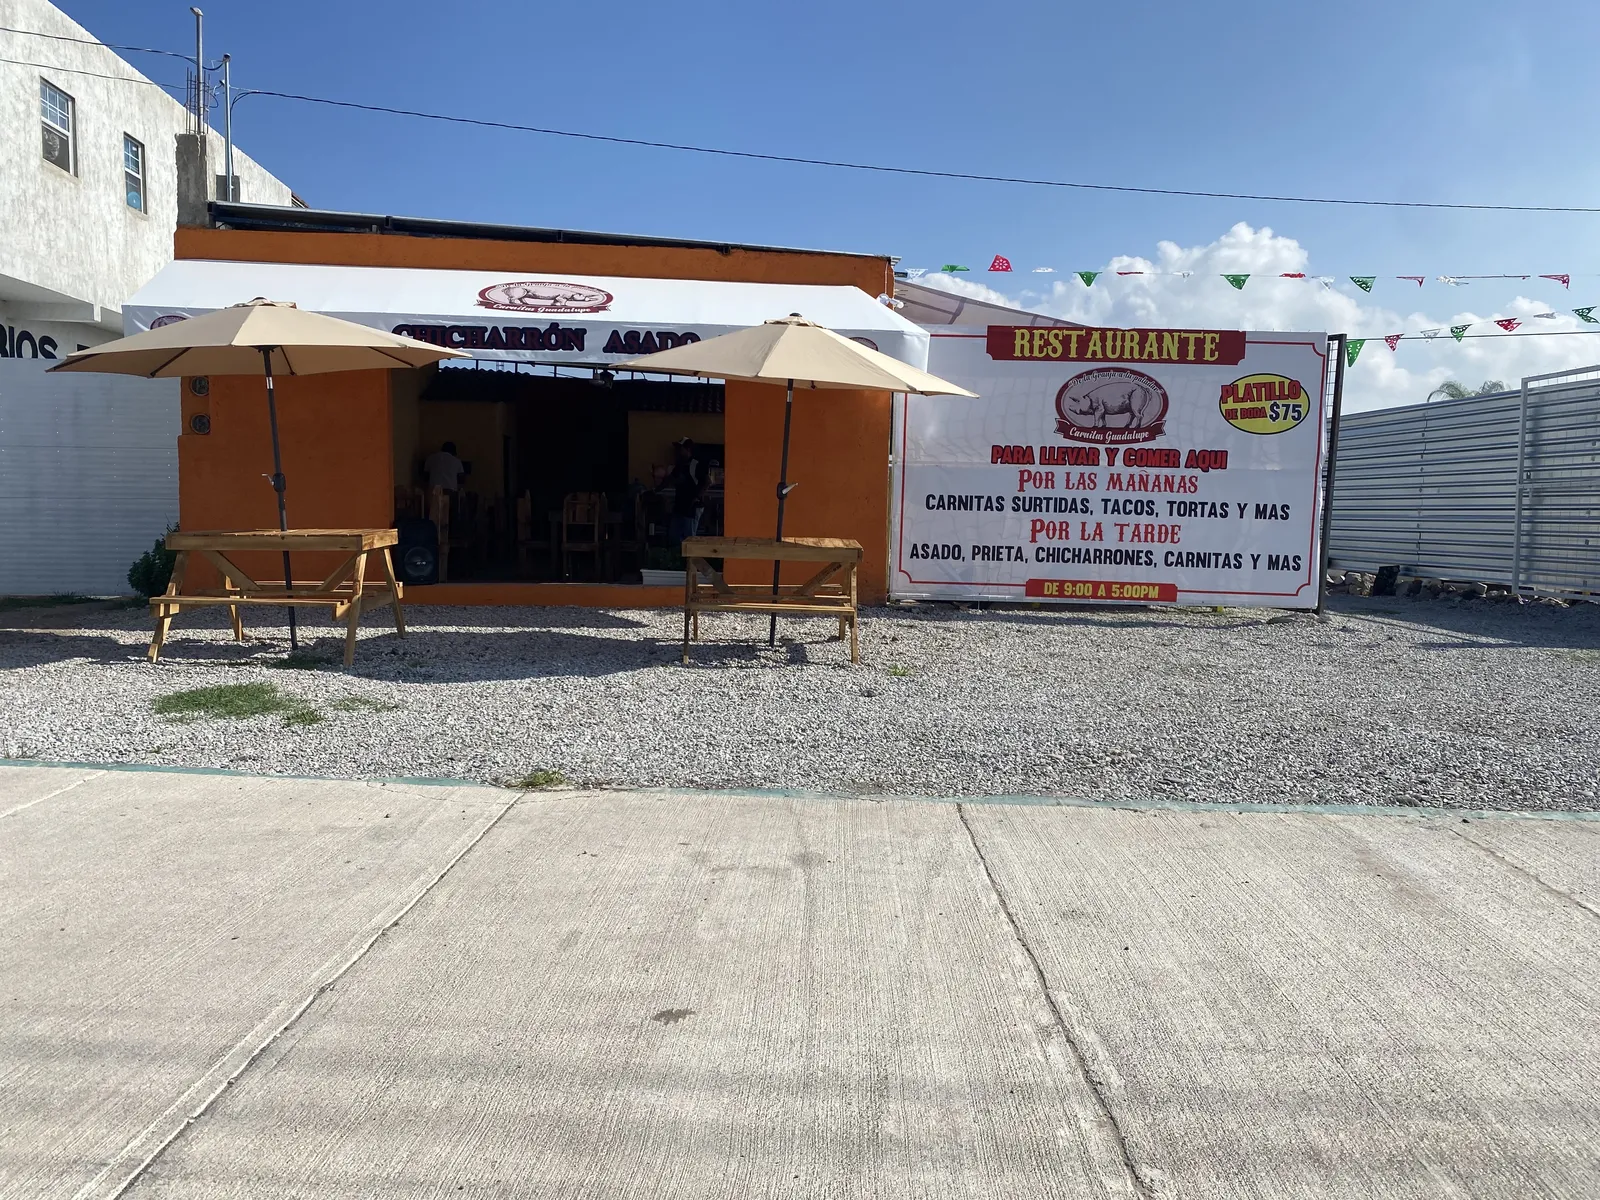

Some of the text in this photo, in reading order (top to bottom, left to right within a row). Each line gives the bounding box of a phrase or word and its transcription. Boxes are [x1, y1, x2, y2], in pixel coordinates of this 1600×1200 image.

[602, 329, 702, 355] ASADO
[1013, 328, 1220, 362] RESTAURANTE
[1221, 380, 1301, 404] PLATILLO
[1225, 401, 1302, 422] DE BODA $75
[1069, 426, 1149, 443] Carnitas Guadalupe
[991, 445, 1228, 472] PARA LLEVAR Y COMER AQUI
[1017, 469, 1198, 494] POR LAS MAÑANAS
[925, 493, 1290, 520] CARNITAS SURTIDAS, TACOS, TORTAS Y MAS
[1029, 518, 1182, 544] POR LA TARDE
[910, 543, 1302, 571] ASADO, PRIETA, CHICHARRONES, CARNITAS Y MAS
[1044, 582, 1159, 599] DE 9:00 A 5:00PM
